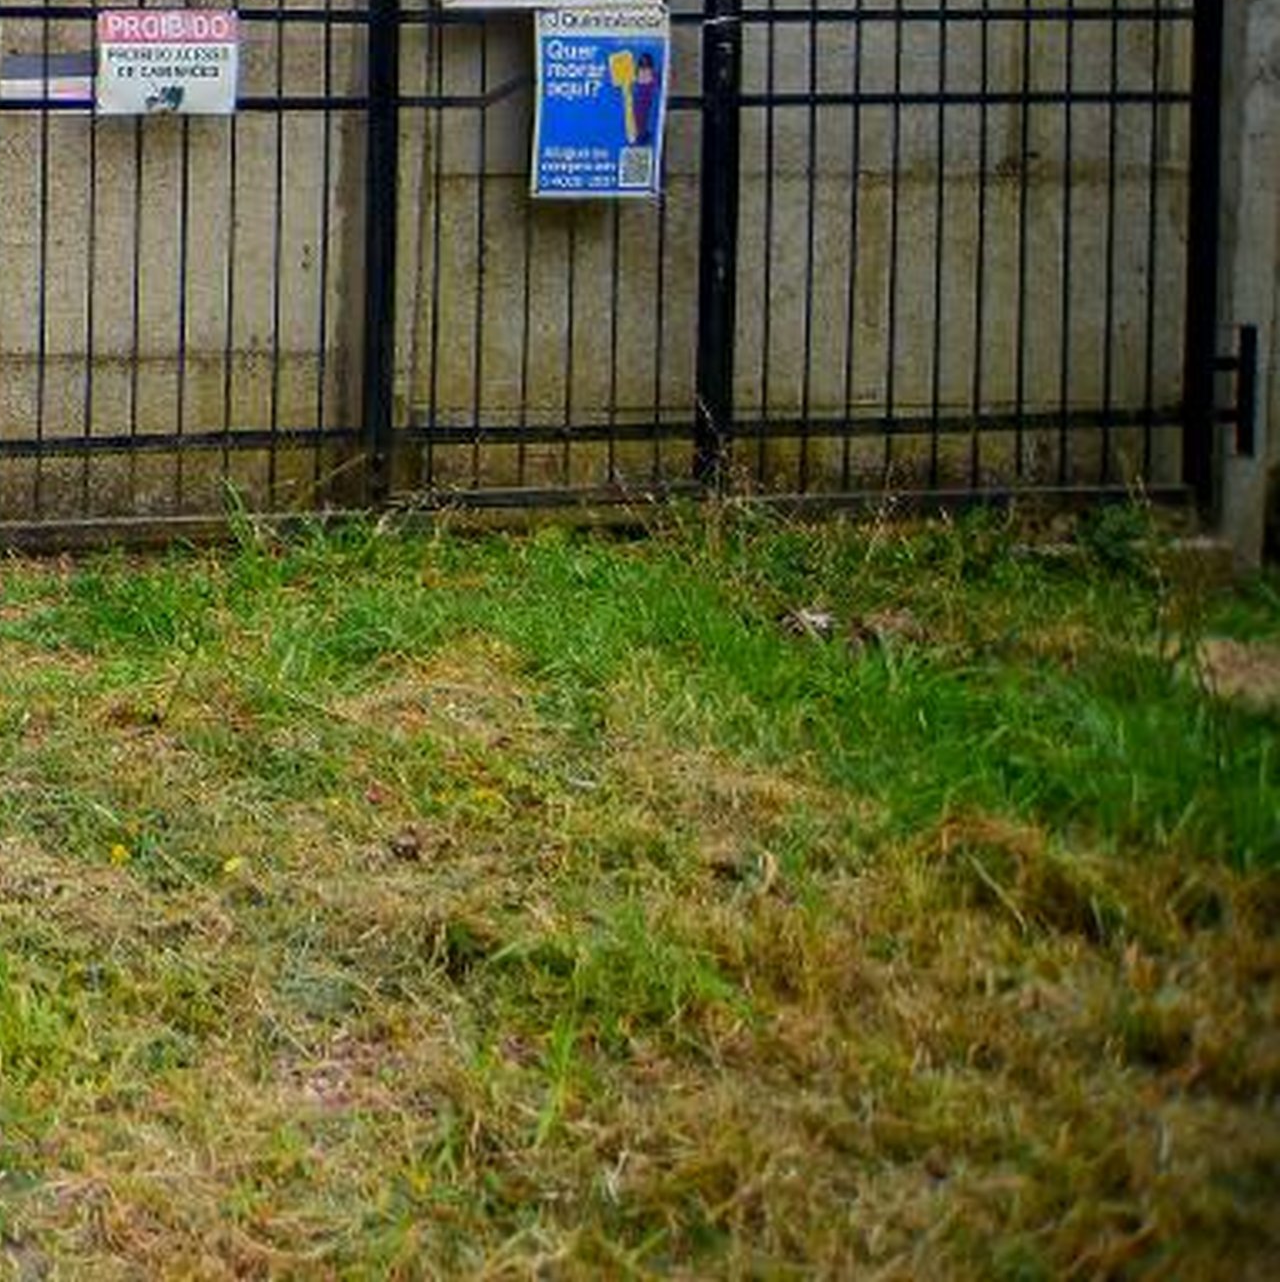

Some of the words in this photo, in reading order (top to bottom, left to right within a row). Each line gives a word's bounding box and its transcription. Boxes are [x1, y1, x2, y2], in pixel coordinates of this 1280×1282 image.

[106, 15, 229, 40] PROIBIDO
[546, 39, 597, 60] Quer
[546, 63, 605, 79] morar
[547, 79, 602, 100] aqui?
